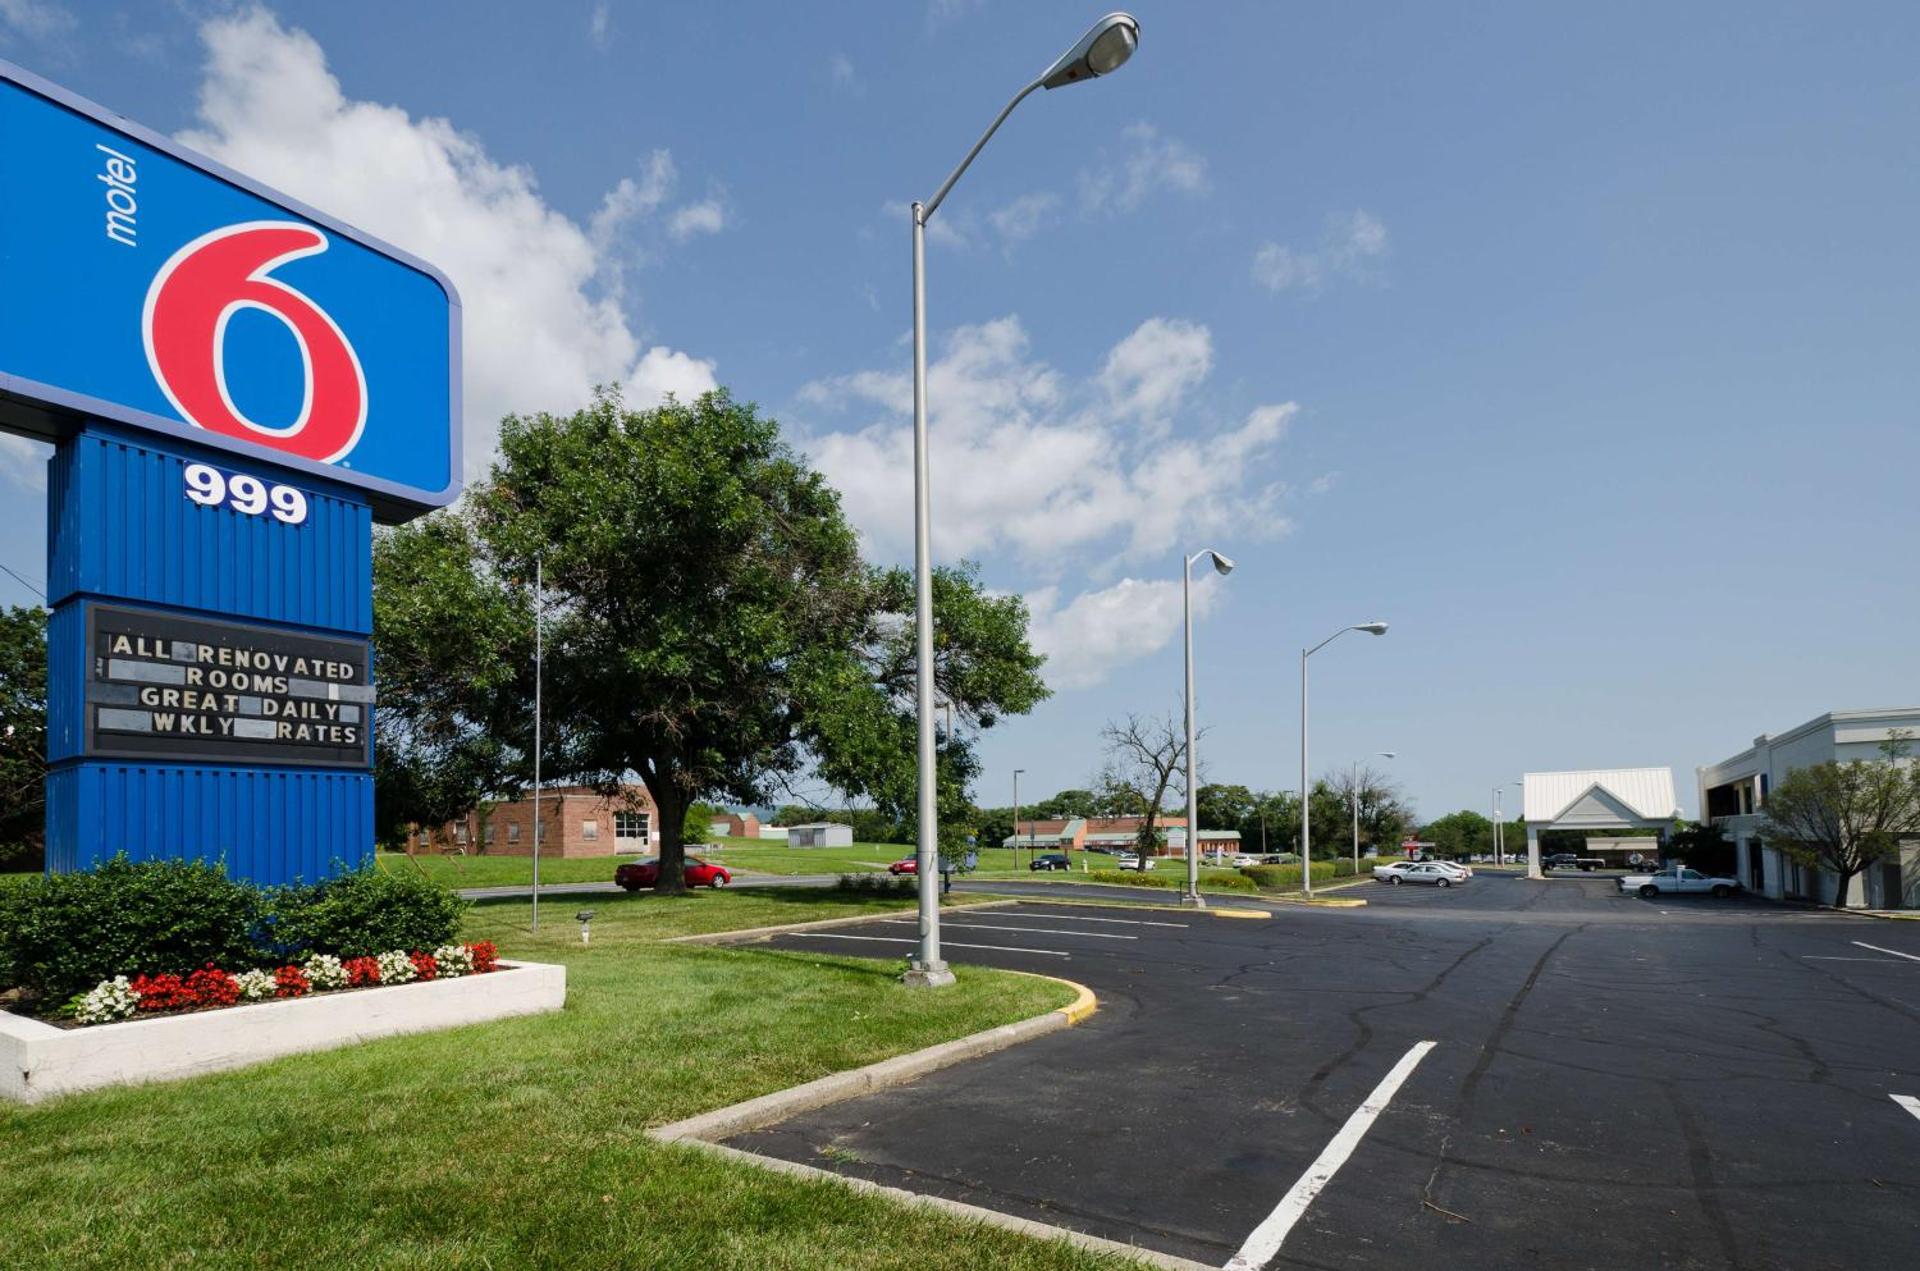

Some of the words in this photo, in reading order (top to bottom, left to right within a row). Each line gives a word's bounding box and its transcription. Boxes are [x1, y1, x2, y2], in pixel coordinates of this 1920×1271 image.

[97, 144, 136, 246] motel
[142, 220, 368, 463] 6
[185, 464, 307, 524] 999
[112, 634, 171, 659] ALL
[198, 645, 354, 679] RENOVATED
[187, 667, 288, 694] ROOMS
[141, 687, 239, 713] GREAT
[262, 698, 339, 720] DAILY
[154, 712, 234, 735] WKLY
[277, 722, 356, 744] RATES
